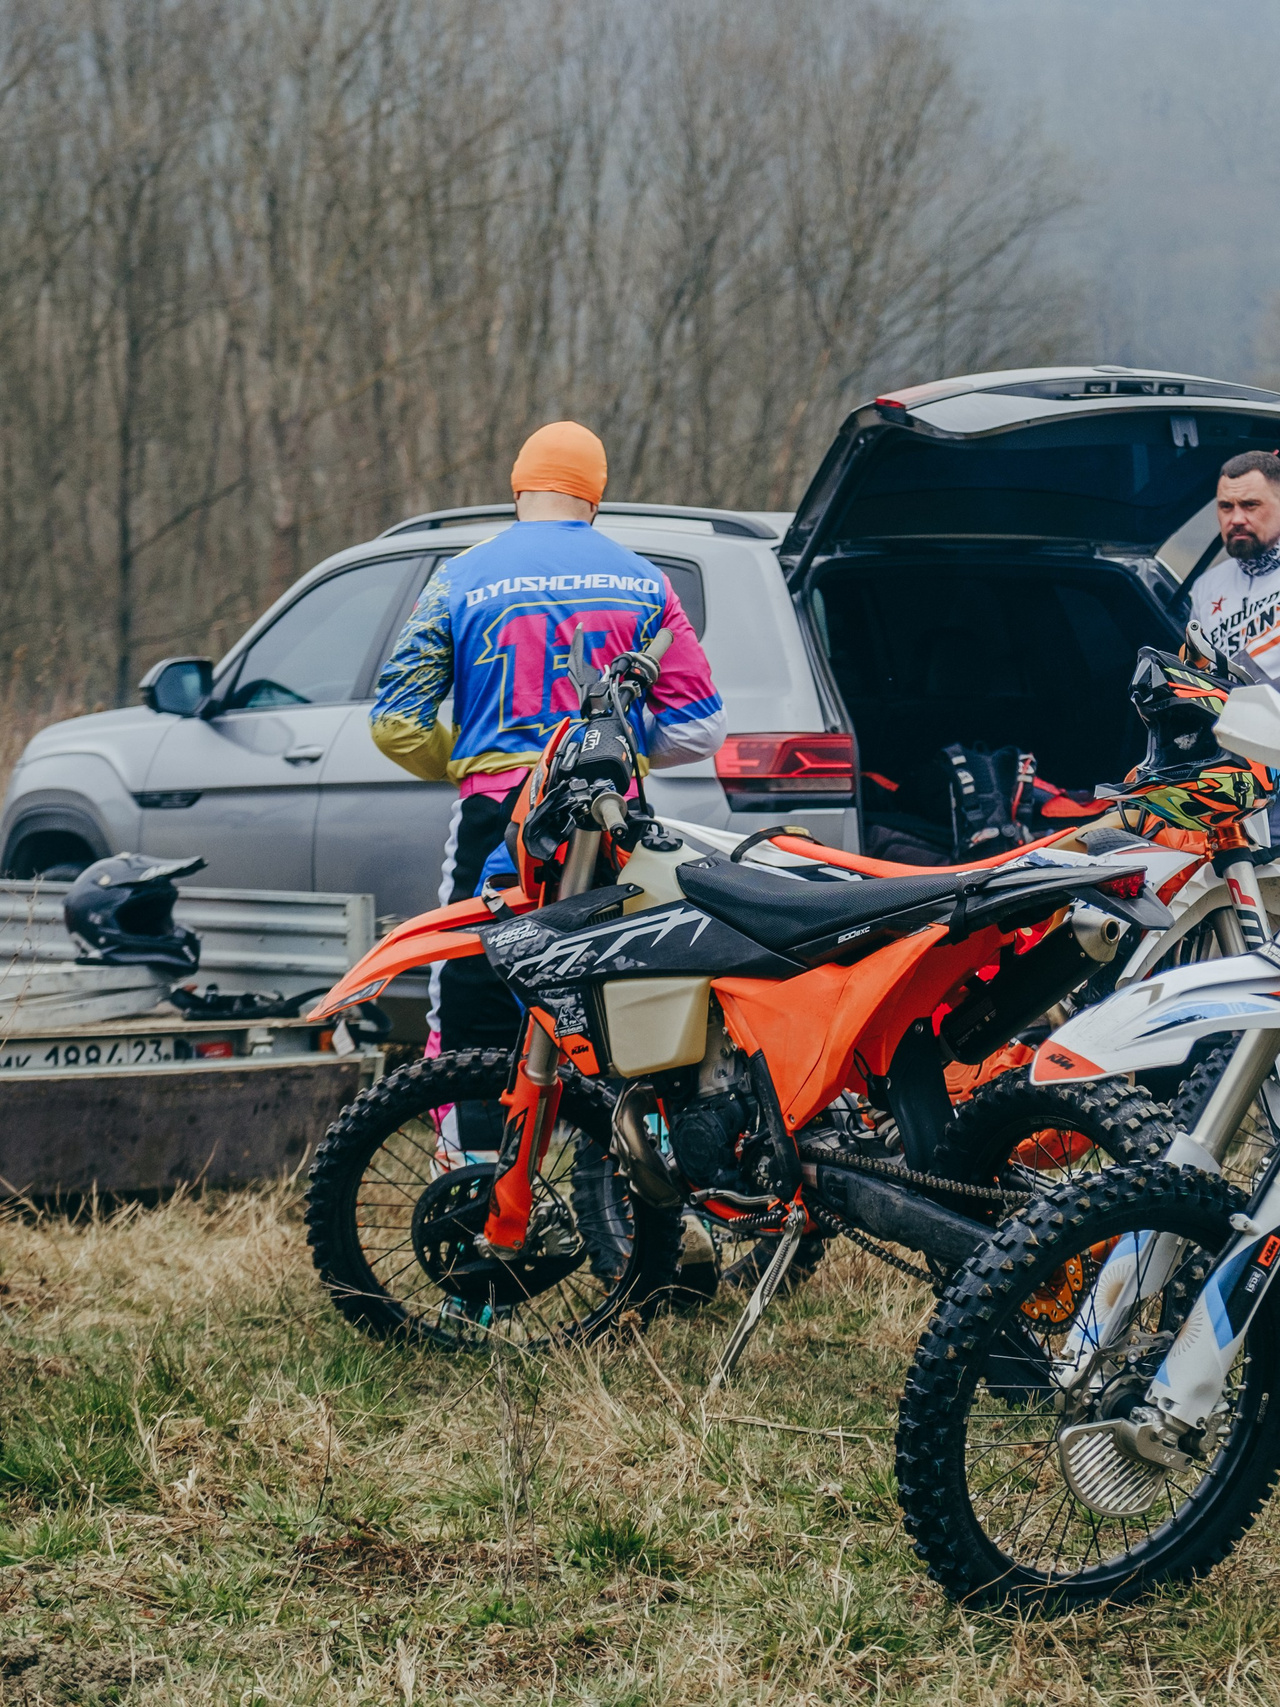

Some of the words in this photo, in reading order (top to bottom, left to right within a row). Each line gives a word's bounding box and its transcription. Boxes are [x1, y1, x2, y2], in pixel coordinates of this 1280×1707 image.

[465, 573, 660, 608] D.YUSHCHENKO
[1210, 590, 1280, 645] ENDURO
[488, 922, 532, 946] HARD
[496, 928, 541, 948] ENDURO
[571, 1045, 589, 1056] KTM
[1045, 1053, 1076, 1070] KTM
[1264, 1241, 1278, 1263] KTM
